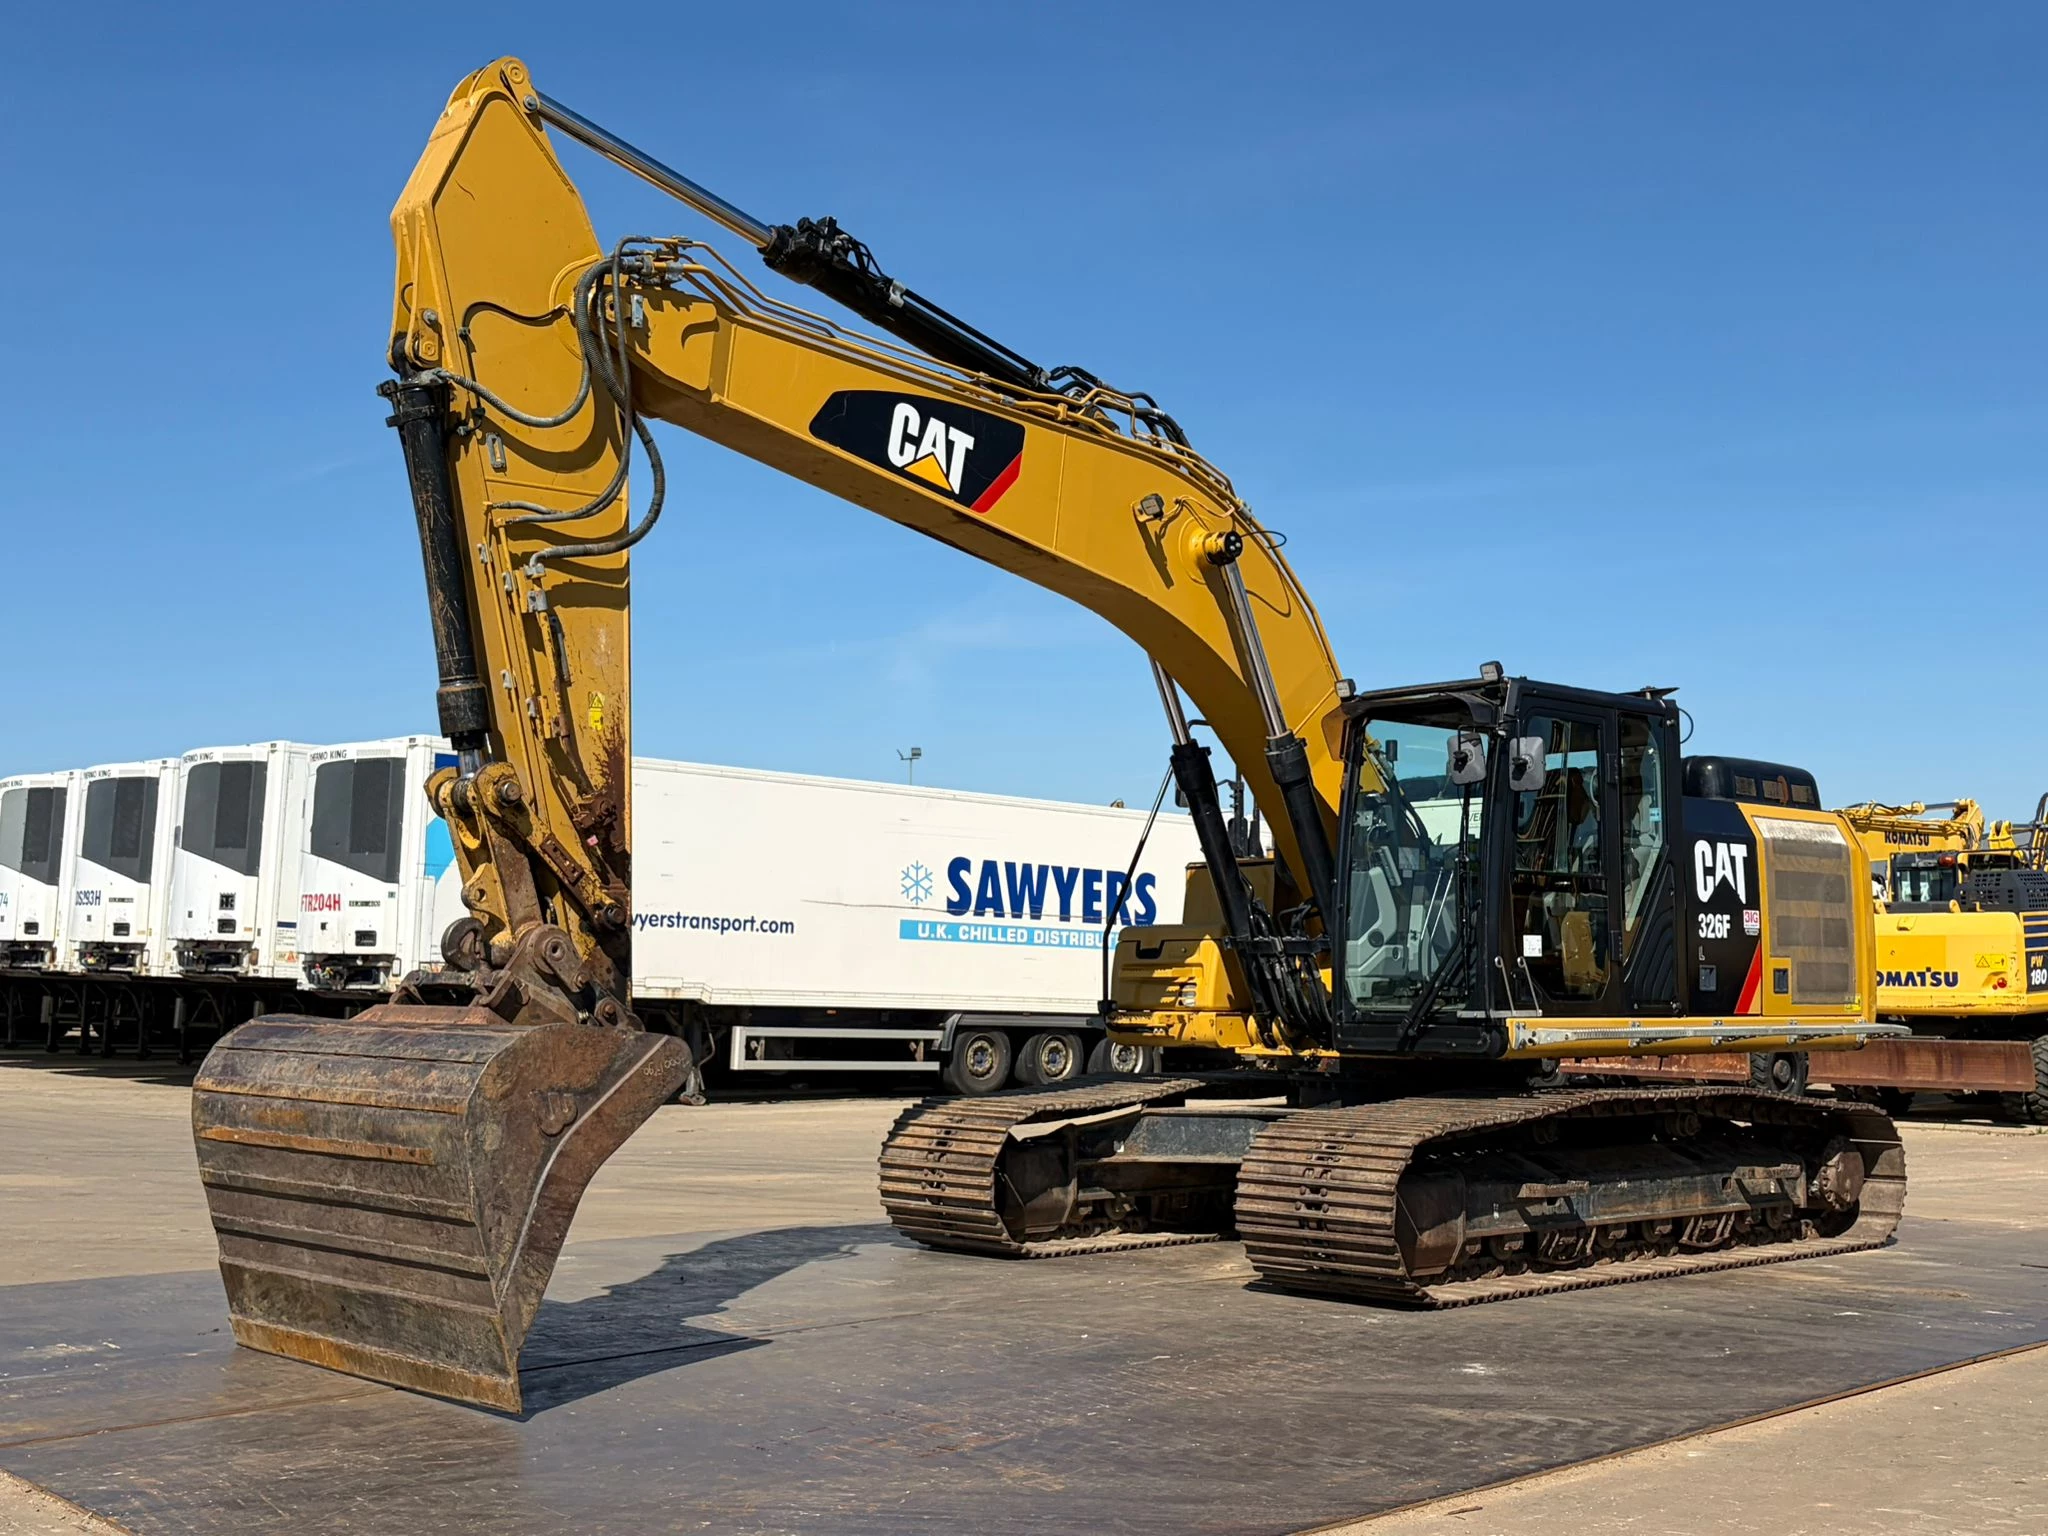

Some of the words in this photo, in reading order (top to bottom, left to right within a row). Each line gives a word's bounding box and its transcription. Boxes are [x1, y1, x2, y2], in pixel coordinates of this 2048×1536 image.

[888, 402, 975, 495] CAT
[329, 749, 347, 759] KING
[1884, 829, 1930, 846] KOMATSU
[1694, 839, 1748, 905] CAT
[300, 893, 341, 912] FTR204H
[946, 856, 1157, 927] SAWYERS
[918, 923, 952, 939] U.K.
[958, 925, 1028, 943] CHILLED
[1033, 929, 1118, 948] DISTRIBUT
[1698, 913, 1731, 939] 326F
[2030, 955, 2044, 968] PW
[1876, 966, 1959, 988] OMATSU
[2030, 968, 2048, 985] 180
